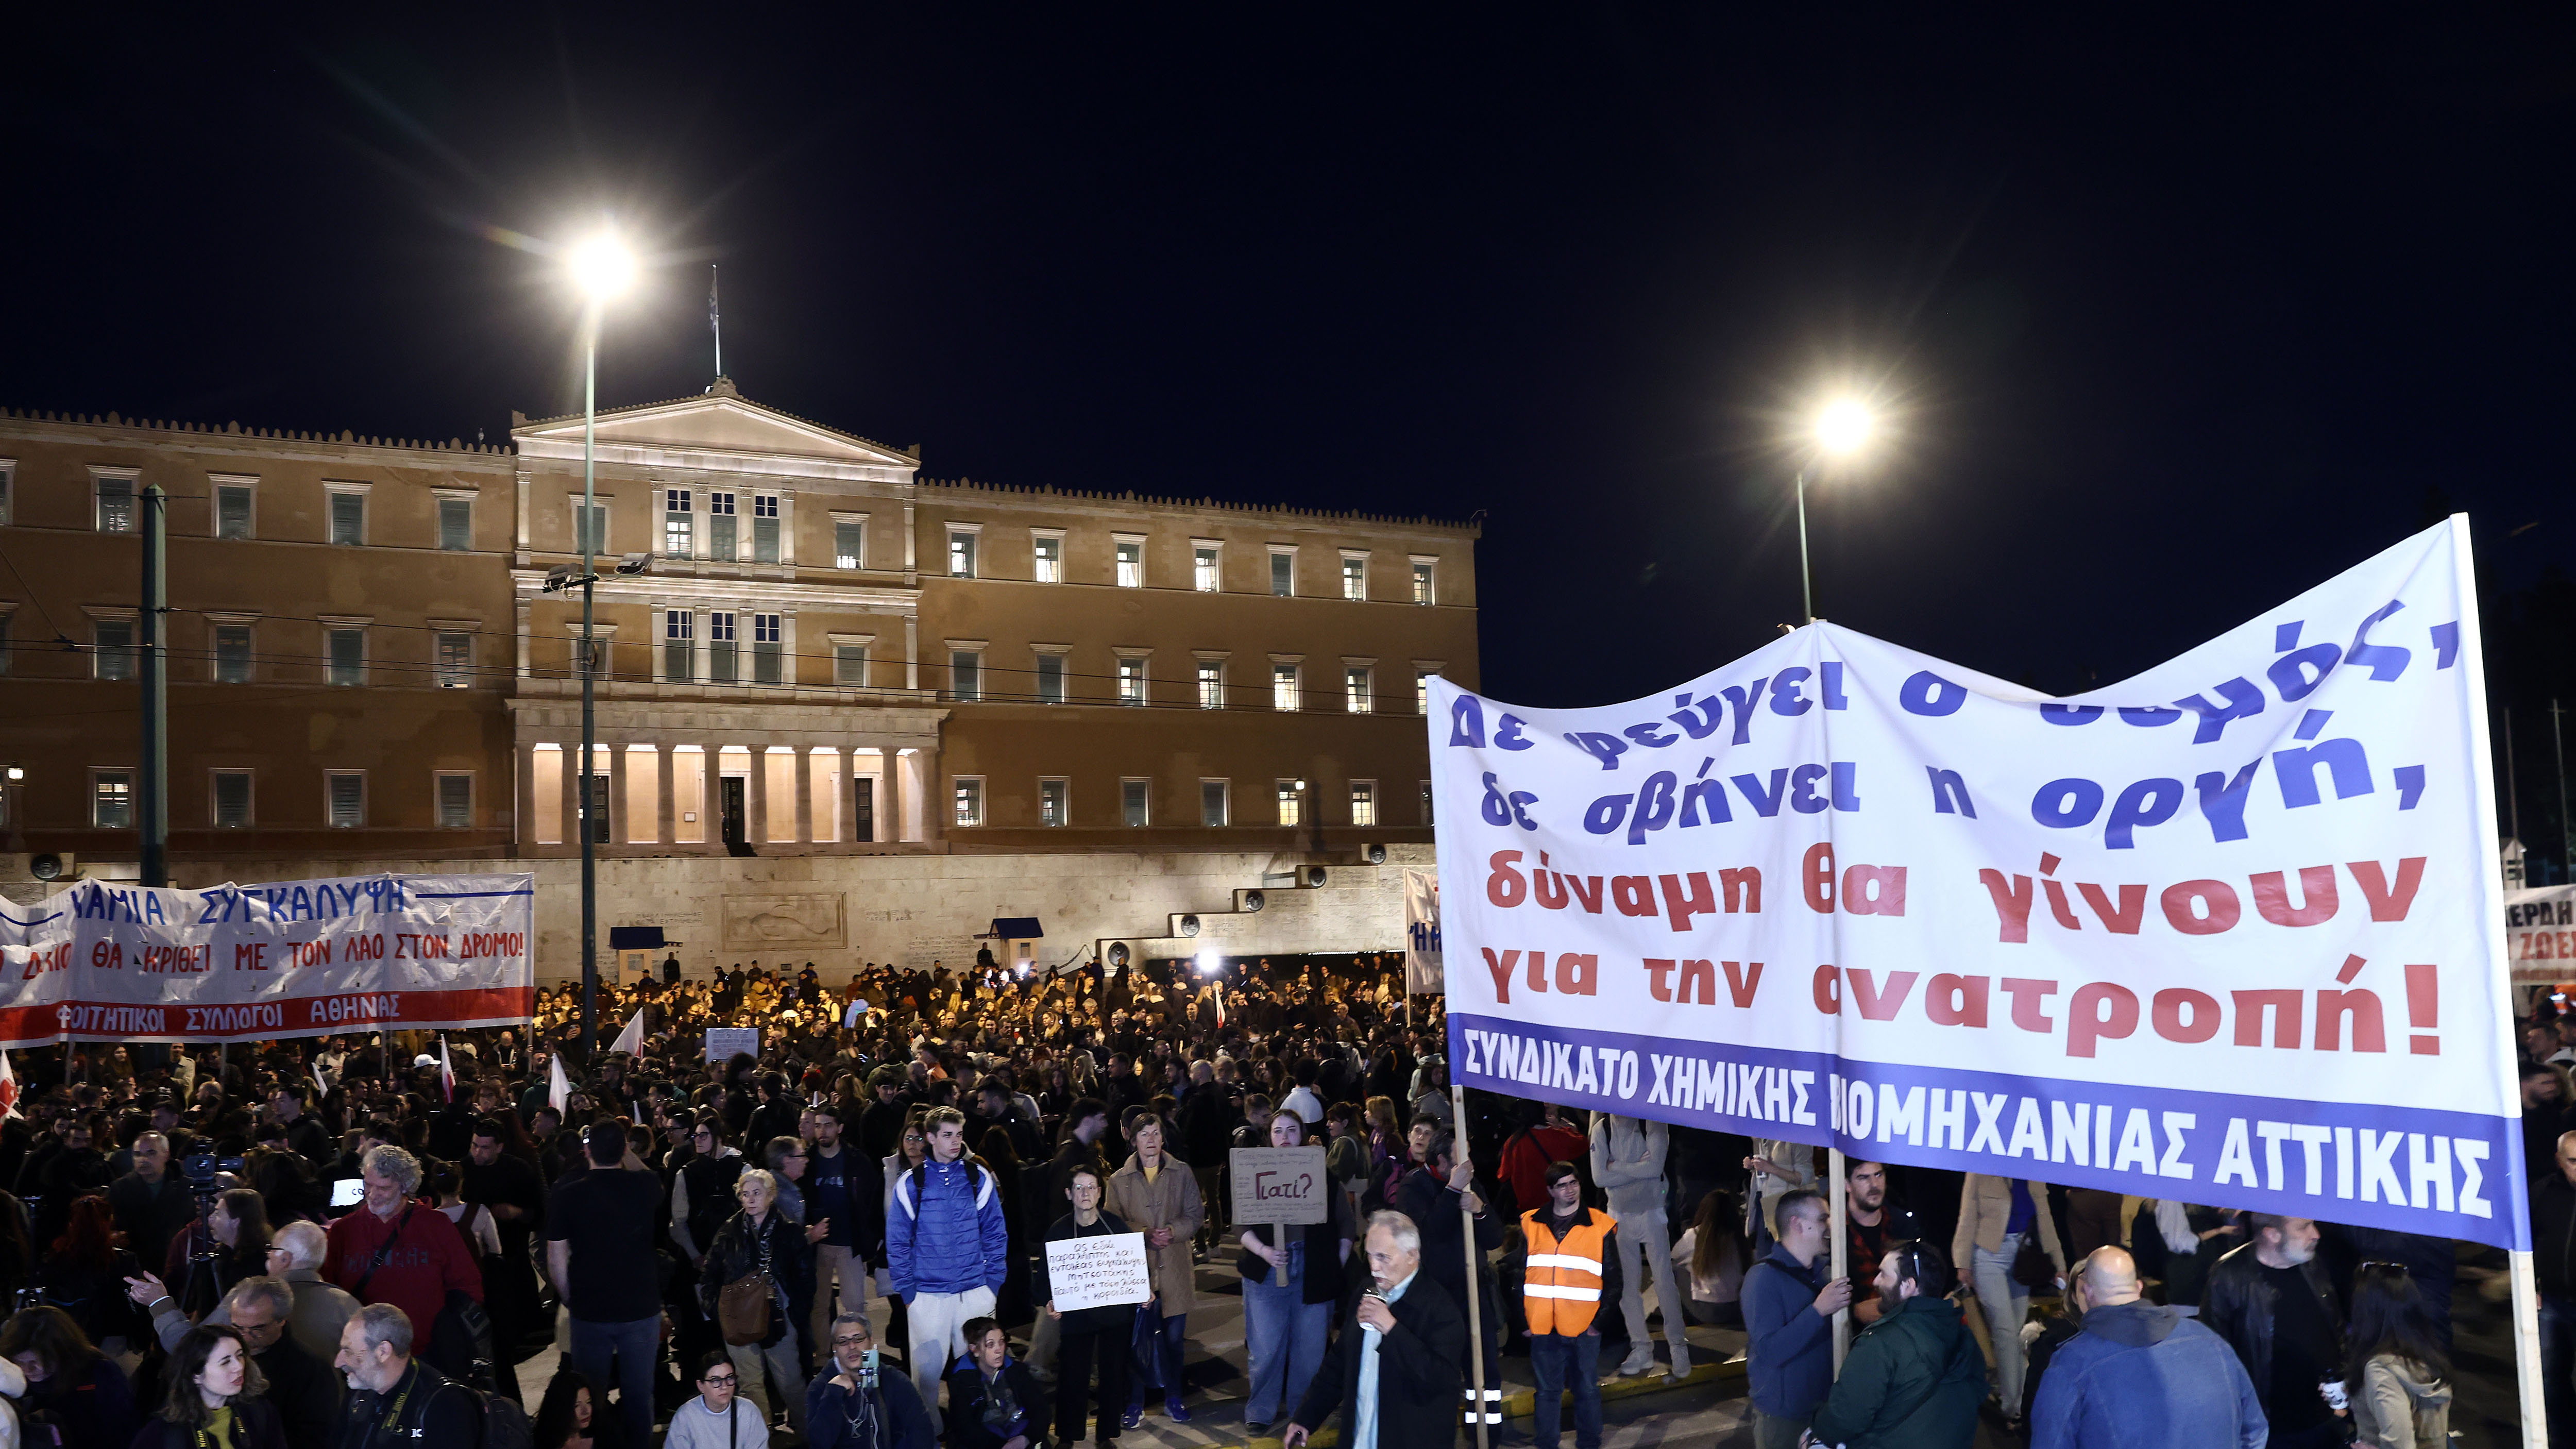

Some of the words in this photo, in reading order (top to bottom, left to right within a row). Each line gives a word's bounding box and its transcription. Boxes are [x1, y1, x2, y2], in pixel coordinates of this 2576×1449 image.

[1449, 695, 1535, 751] Δε
[1564, 662, 1849, 770] φεύγει
[1899, 670, 1968, 717] ο
[1482, 772, 1539, 831] δε
[1583, 757, 1861, 846] σβήνει
[1926, 765, 1977, 820] η
[2030, 709, 2426, 850] οργή,
[71, 884, 165, 925] ΚΑΜΙΑ
[198, 880, 404, 924] ΣΥΓΚΑΛΥΨΗ
[1487, 850, 1761, 932] δύναμη
[1803, 842, 1907, 917] θα
[1979, 852, 2427, 943] γίνουν
[2507, 901, 2572, 928] ΕΡΔΗ
[92, 941, 123, 970] ΘΑ
[144, 944, 211, 973] ΚΡΙΘΕΙ
[235, 942, 268, 971] ΜΕ
[286, 939, 331, 968] ΤΟΝ
[345, 933, 384, 963] ΛΑΟ
[395, 933, 448, 959] ΣΤΟΝ
[460, 931, 523, 959] ΔΡΟΜΟ!
[56, 1004, 165, 1032] ΦΟΙΤΗΤΙΚΟΙ
[185, 1003, 283, 1031] ΣΥΛΛΟΓΟΙ
[310, 993, 400, 1023] ΑΘΗΝΑΣ
[1482, 947, 1598, 1004] για
[1643, 958, 1764, 1008] την
[1813, 954, 2440, 1057] ανατροπή!
[1464, 1028, 1639, 1100] ΣΥΝΔΙΚΑΤΟ
[1647, 1054, 1817, 1127] ΧΗΜΙΚΗΣ
[1829, 1073, 2197, 1181] ΒΙΟΜΗΧΑΝΙΑΣ
[2213, 1118, 2493, 1220] ΑΤΤΙΚΗΣ
[1256, 1171, 1313, 1200] Γιατί?
